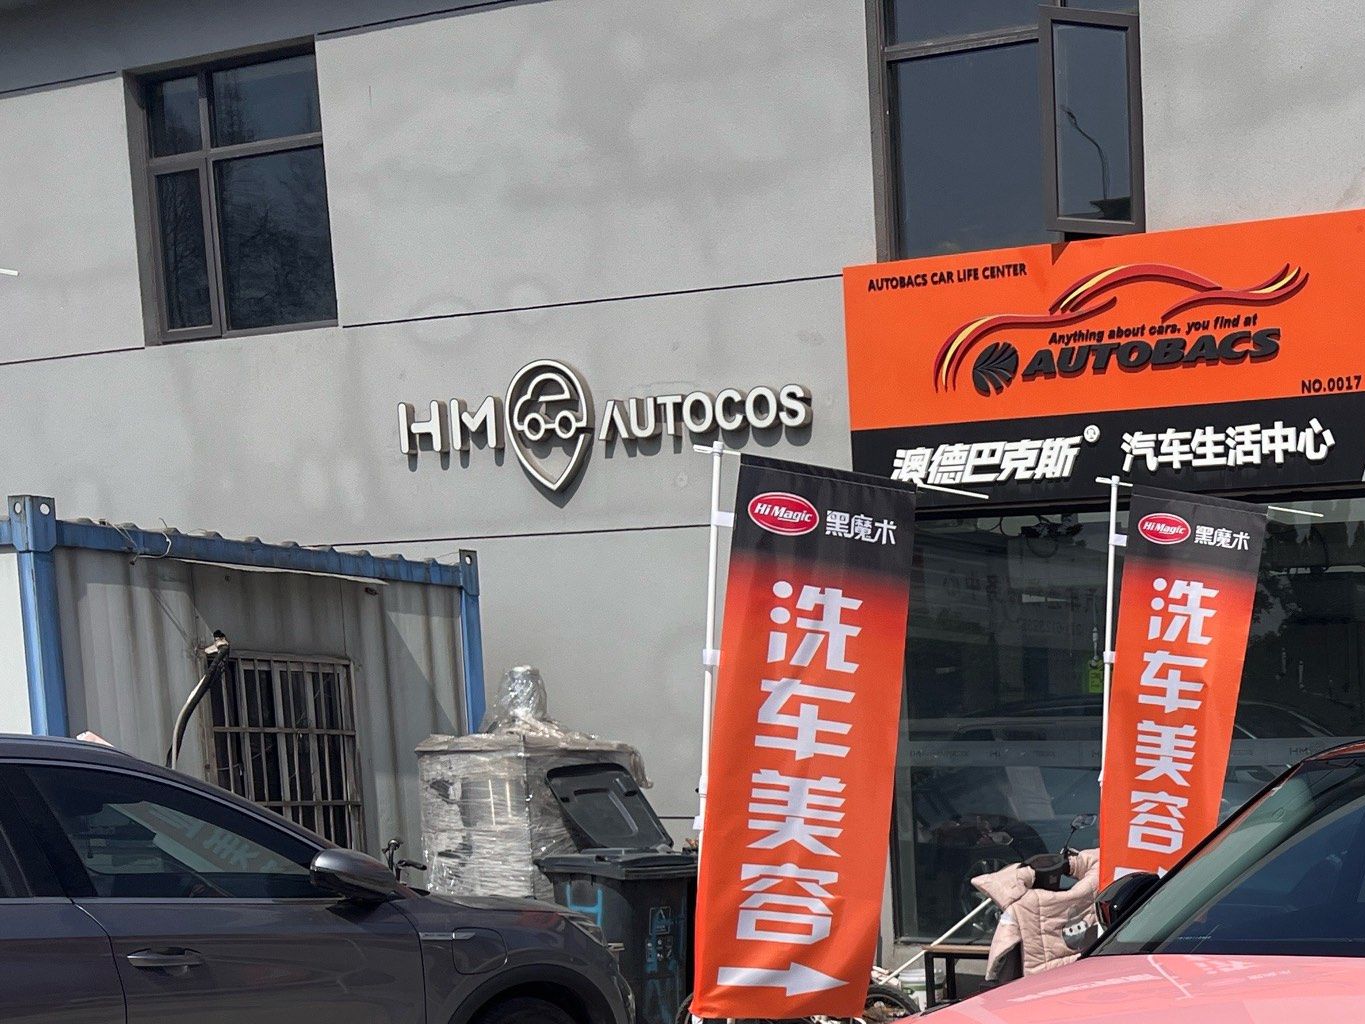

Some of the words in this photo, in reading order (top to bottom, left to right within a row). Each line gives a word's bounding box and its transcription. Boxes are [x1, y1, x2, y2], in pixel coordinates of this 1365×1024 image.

[868, 274, 927, 292] AUTOBACS
[931, 271, 954, 285] CAR
[957, 268, 979, 283] LIFE
[982, 263, 1027, 280] CENTER
[1048, 328, 1104, 346] Anything
[1108, 325, 1146, 341] about
[1186, 321, 1210, 336] you
[1214, 316, 1241, 330] find
[1243, 313, 1258, 328] at
[1021, 327, 1281, 380] AUTOBACS
[1301, 375, 1362, 394] NO.0017
[398, 395, 503, 455] HM
[599, 384, 812, 441] AUTOCOS
[1121, 417, 1336, 473] 汽车生活中心
[754, 503, 771, 515] Hi
[773, 506, 813, 522] Magic
[825, 510, 898, 545] 黑魔术
[1142, 521, 1154, 531] Hi
[1155, 523, 1186, 535] Magic
[1194, 525, 1251, 551] 黑魔术
[1127, 577, 1219, 855] 洗车美容
[735, 579, 864, 946] 洗车美容
